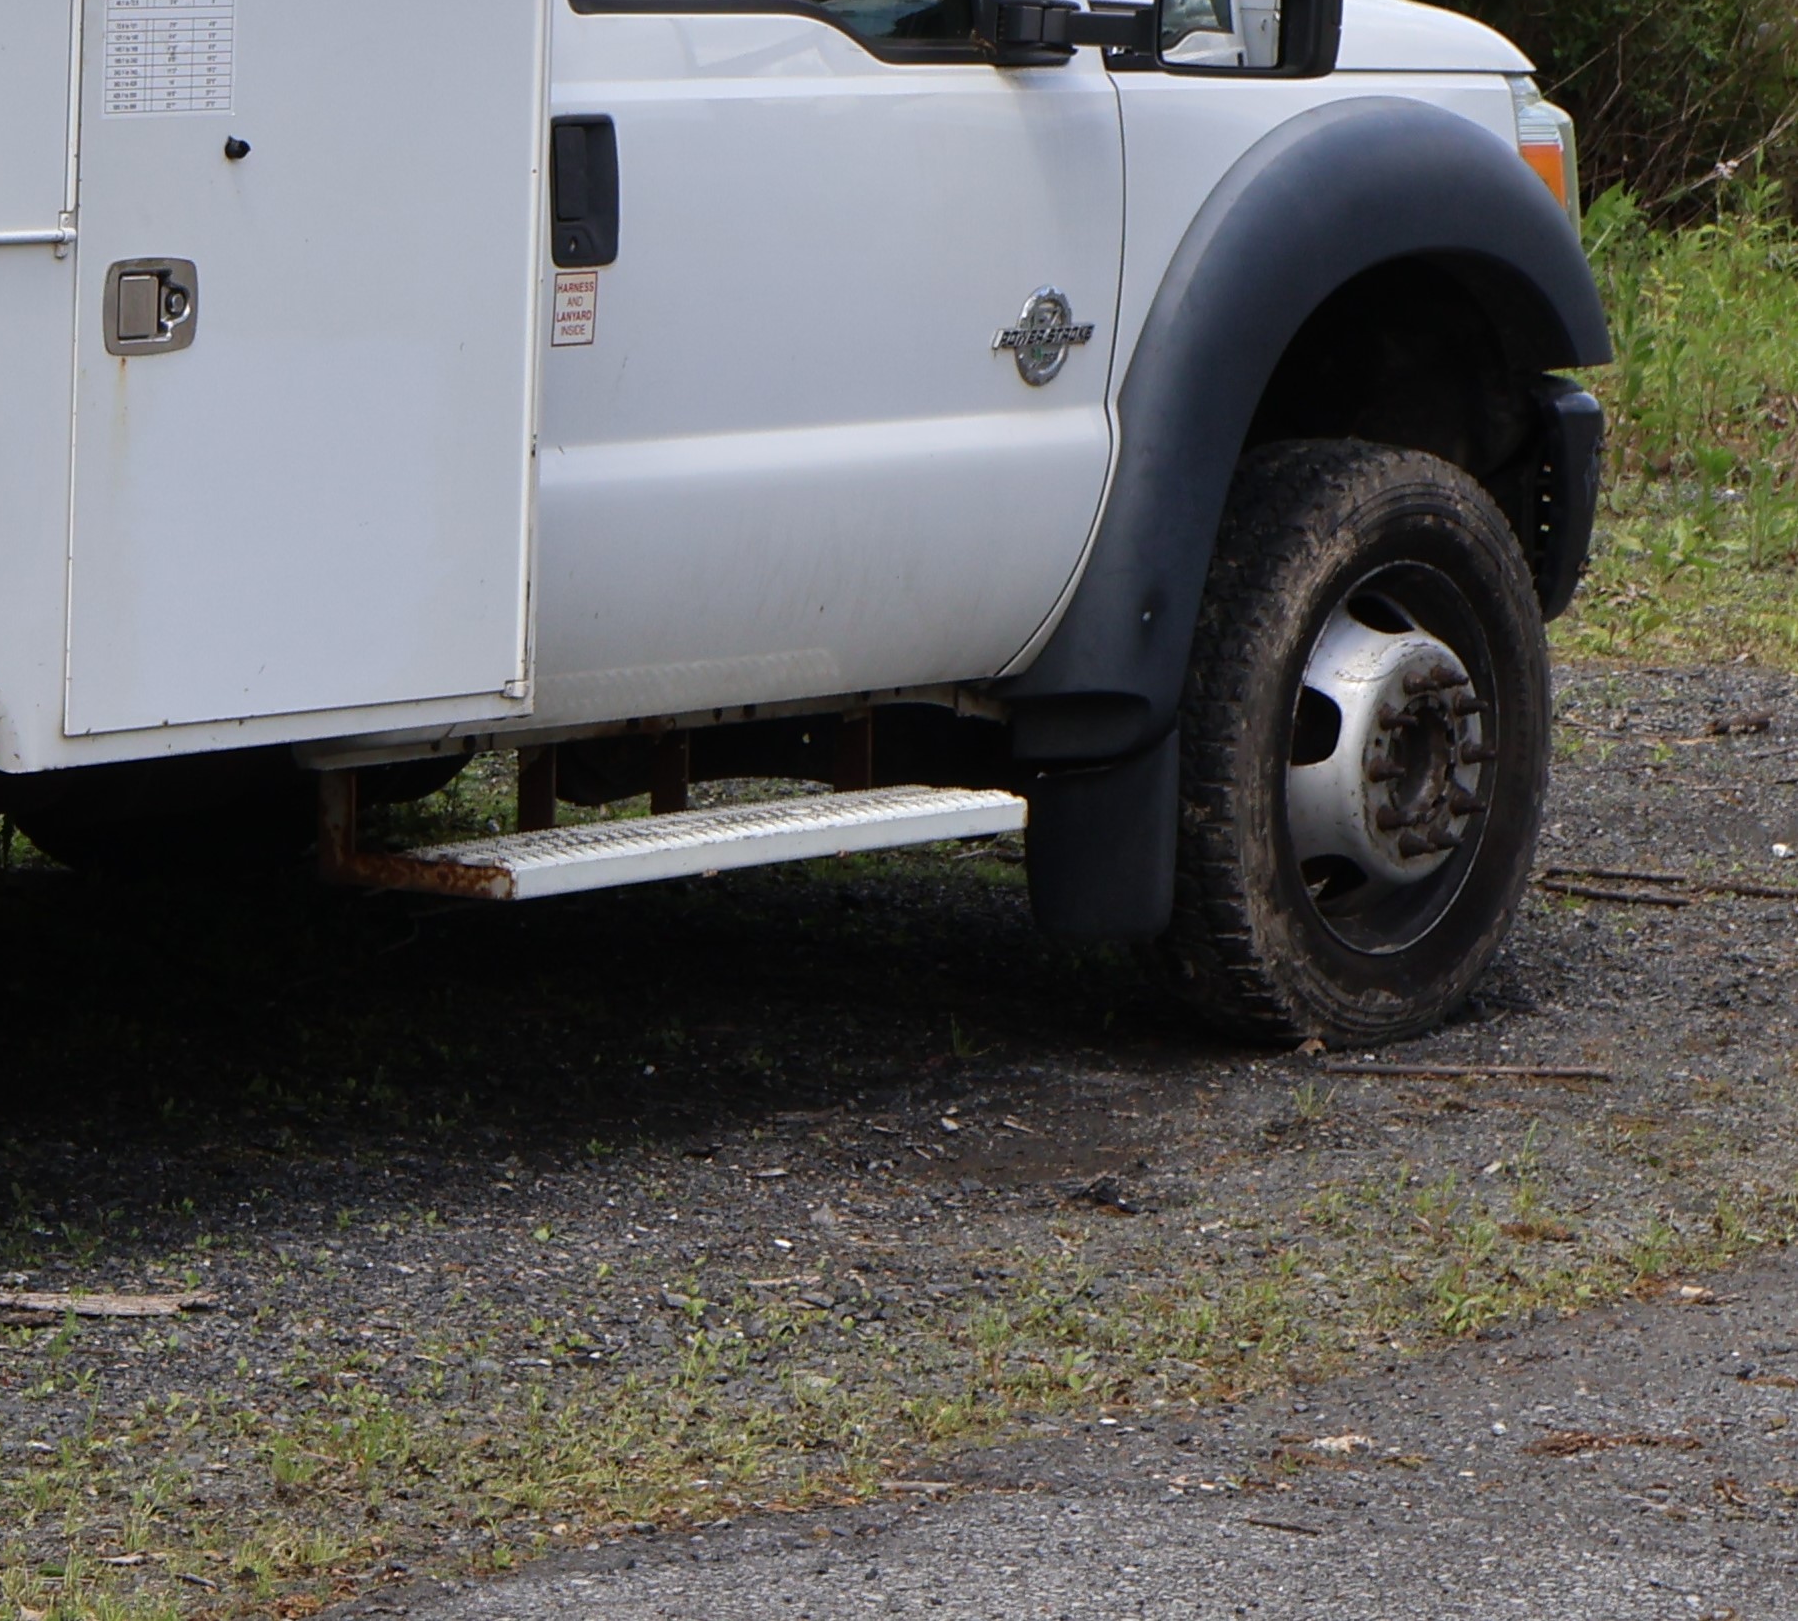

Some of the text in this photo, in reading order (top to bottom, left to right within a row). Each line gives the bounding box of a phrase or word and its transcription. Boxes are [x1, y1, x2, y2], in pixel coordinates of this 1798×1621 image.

[557, 282, 594, 293] HARNESS
[567, 296, 583, 307] AND
[556, 310, 592, 322] LANYARD
[561, 325, 586, 335] INSIDE
[1002, 326, 1093, 346] POWER STROKE
